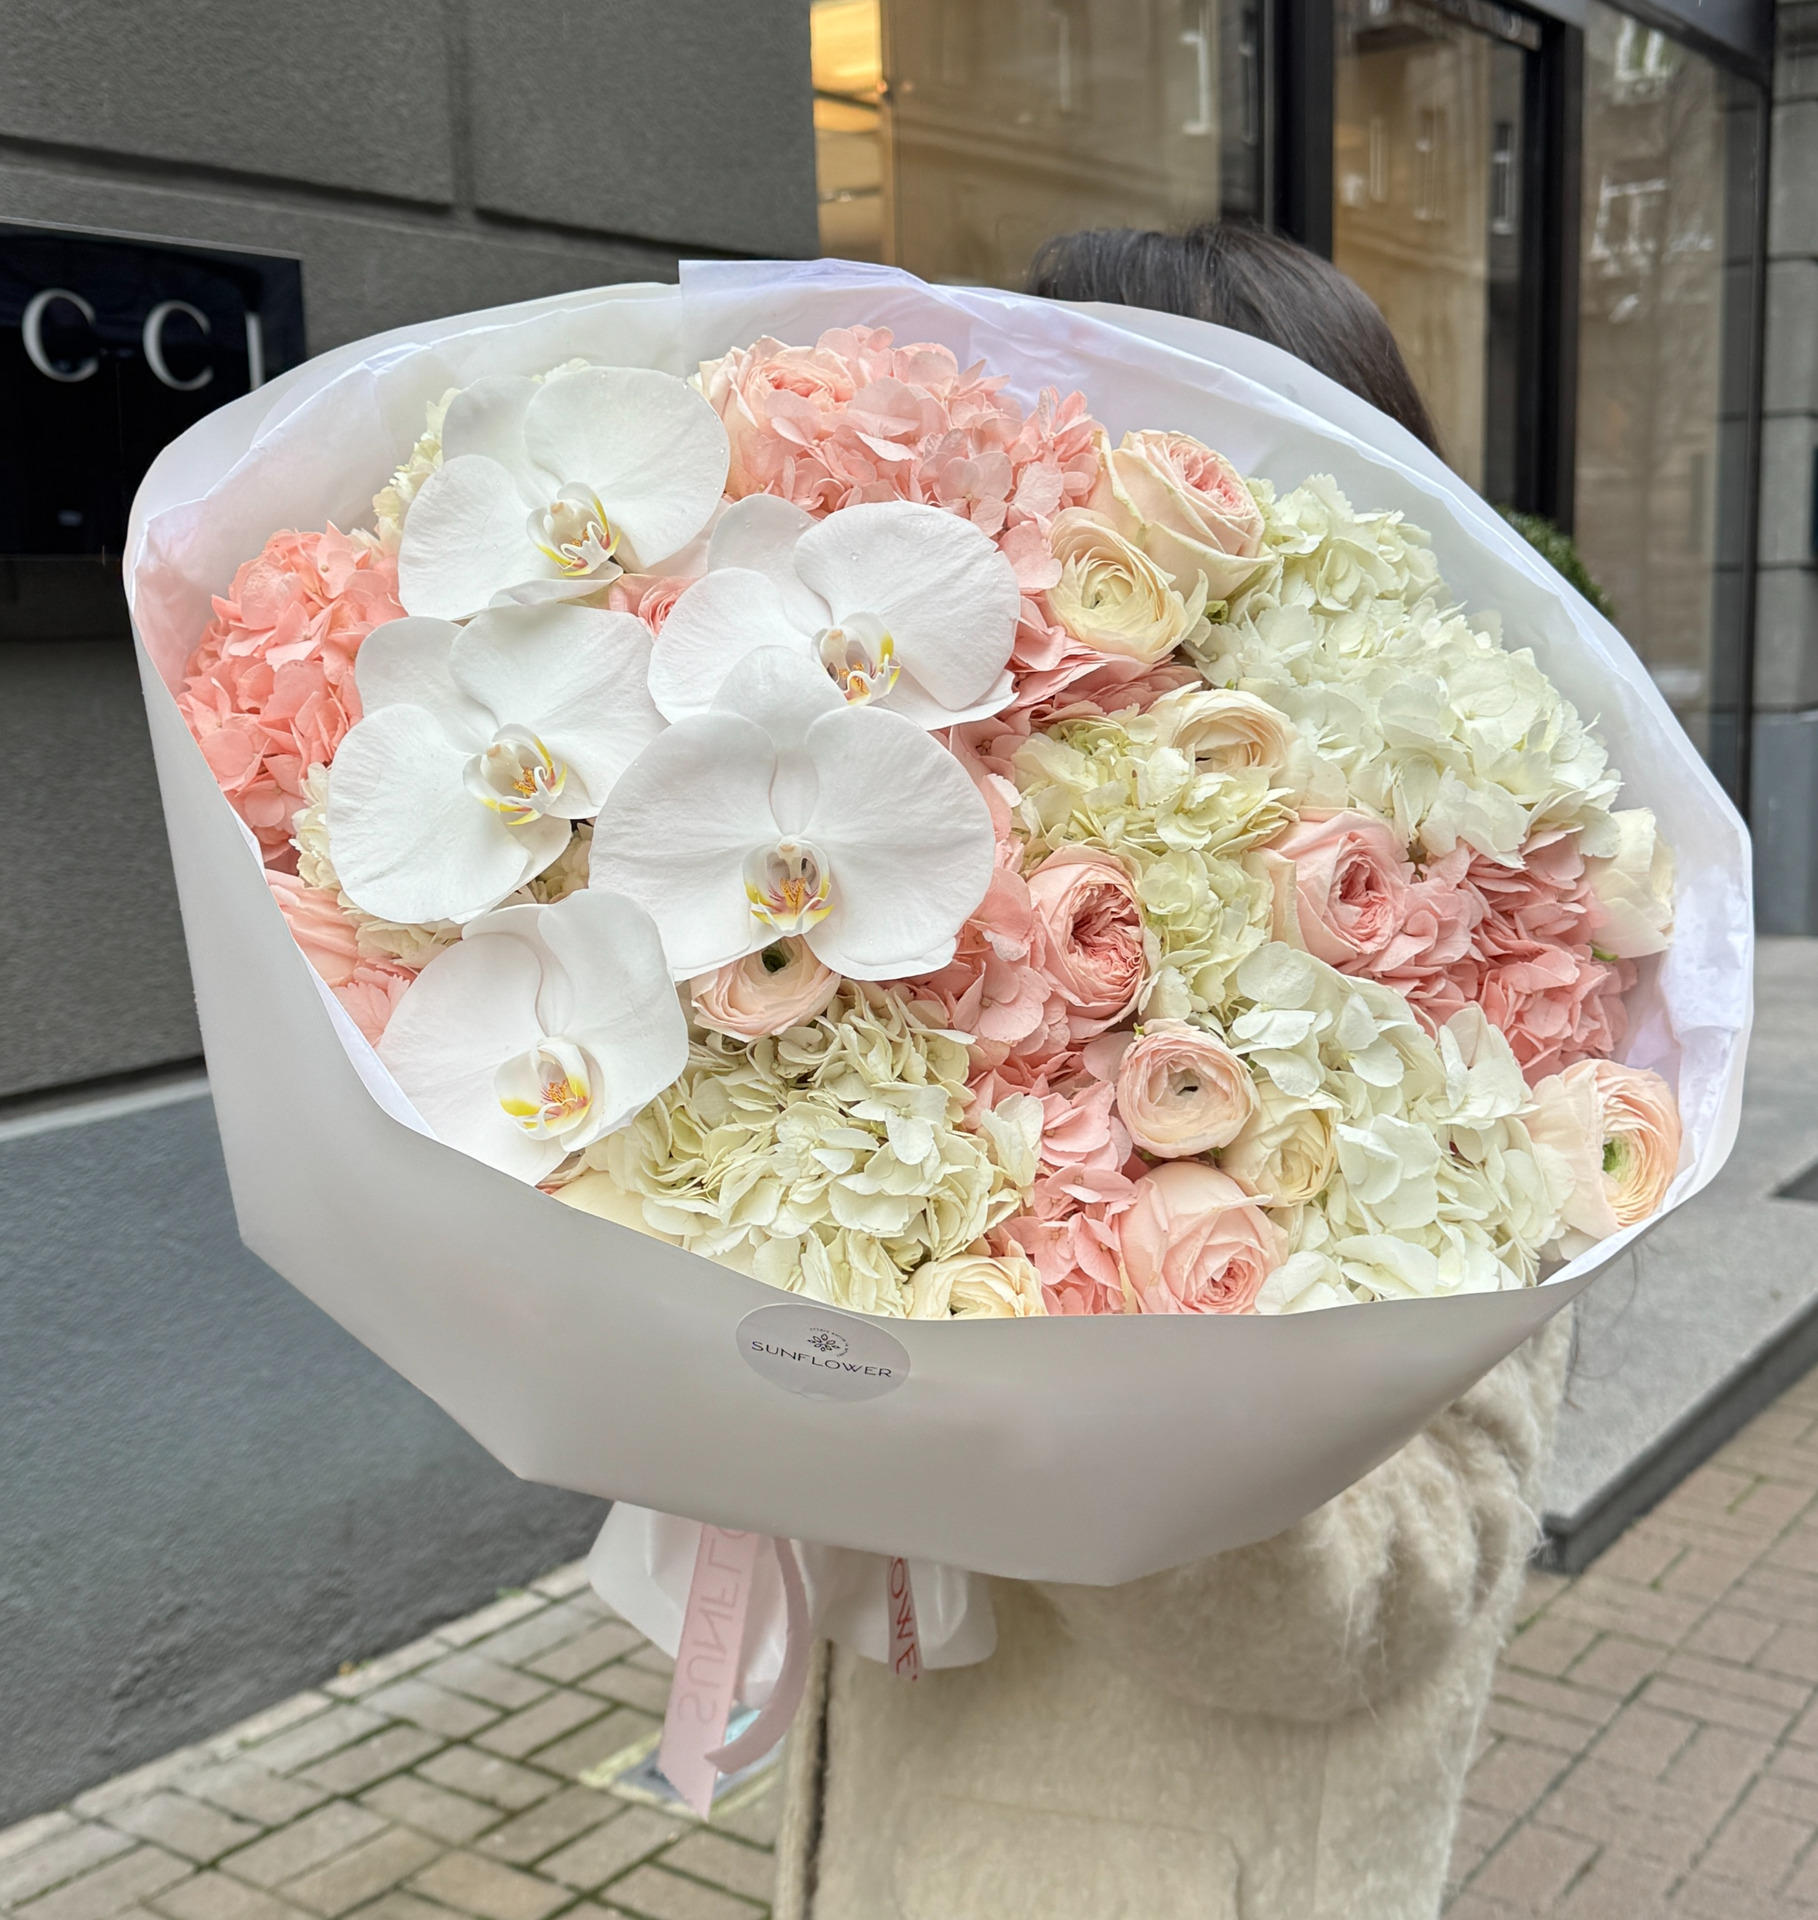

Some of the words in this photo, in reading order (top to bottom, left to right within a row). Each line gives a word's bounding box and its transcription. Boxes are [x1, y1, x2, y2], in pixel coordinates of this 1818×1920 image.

[22, 288, 264, 391] CCI
[751, 1341, 892, 1378] SUNFLOWER
[890, 1556, 918, 1681] OWE
